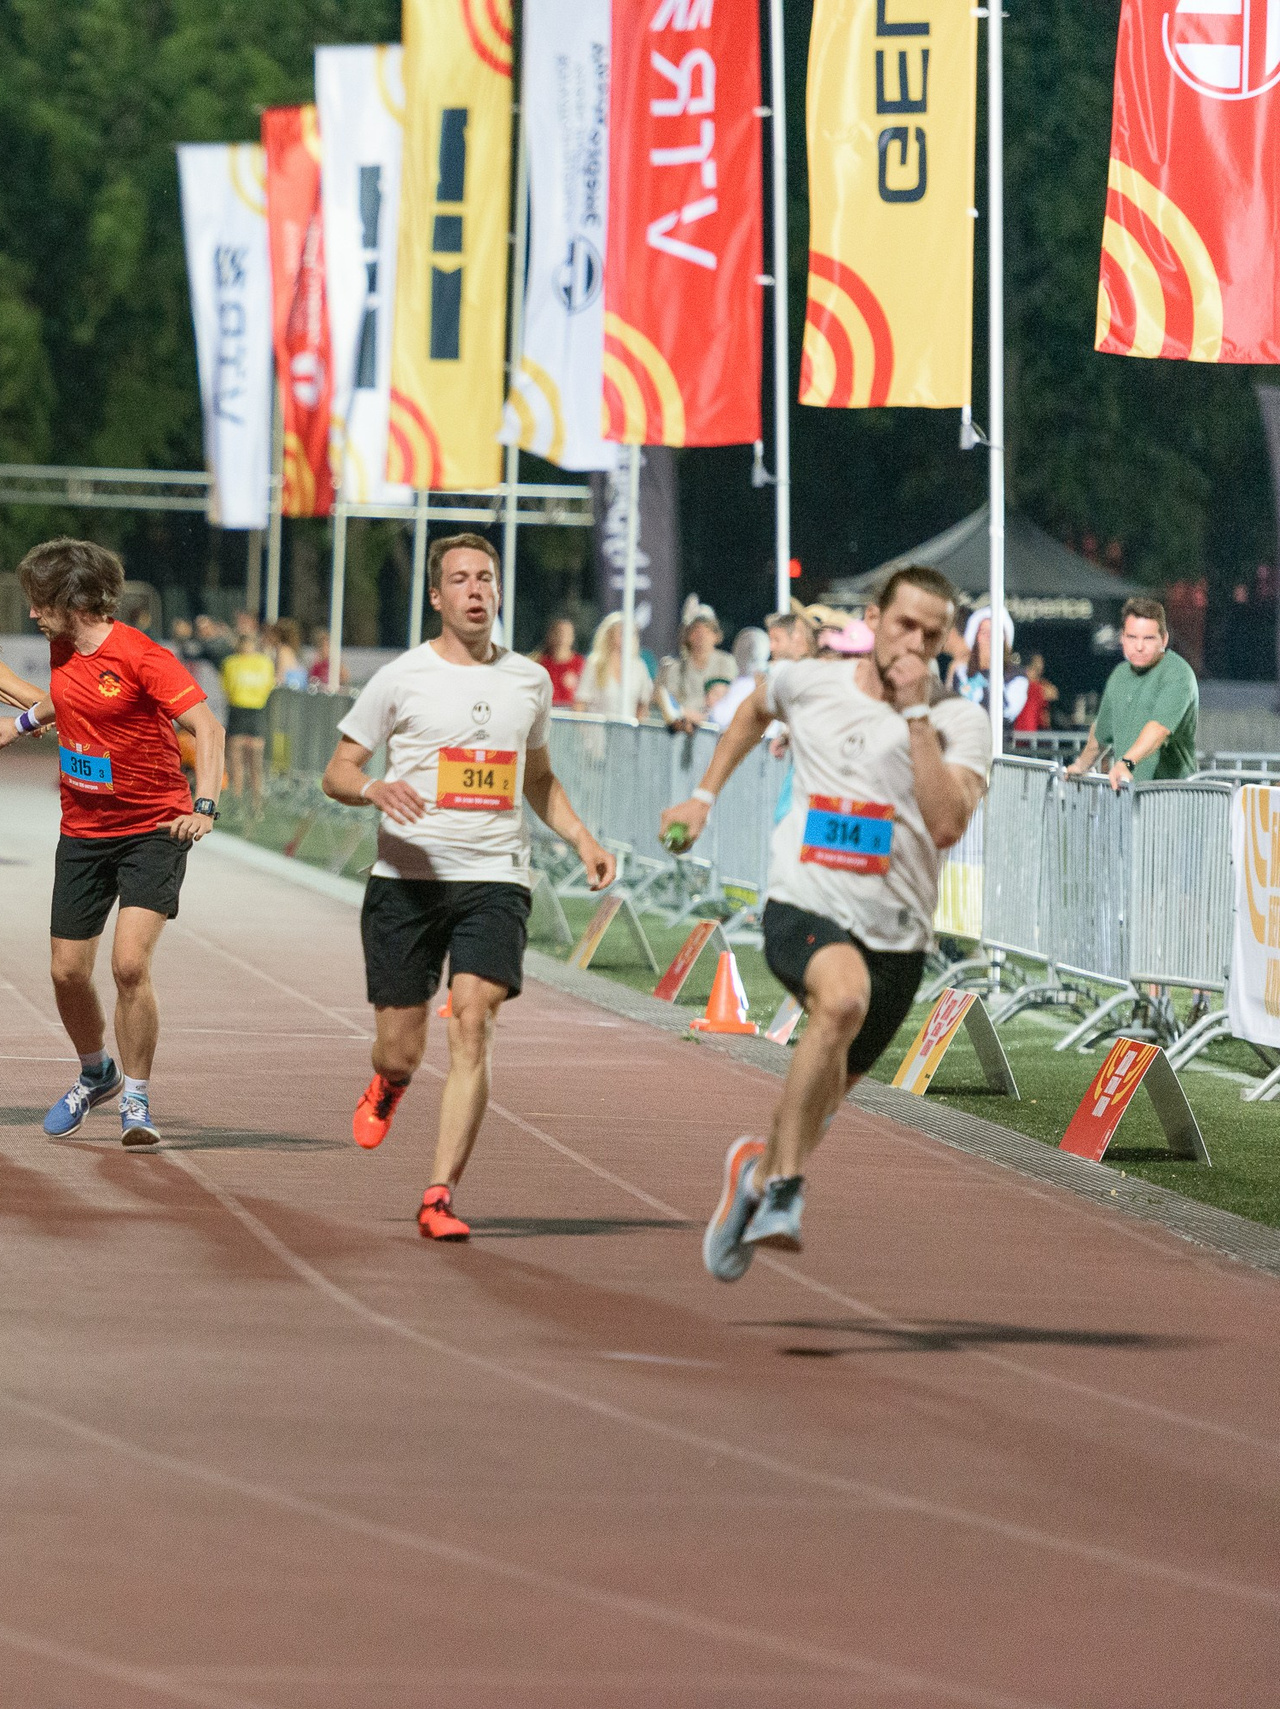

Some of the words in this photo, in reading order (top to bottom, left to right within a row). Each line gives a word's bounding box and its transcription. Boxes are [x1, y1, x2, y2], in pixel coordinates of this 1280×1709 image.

[70, 756, 92, 777] 315
[98, 769, 105, 779] 3
[462, 768, 495, 789] 314
[503, 780, 509, 790] 2
[825, 820, 860, 845] 314
